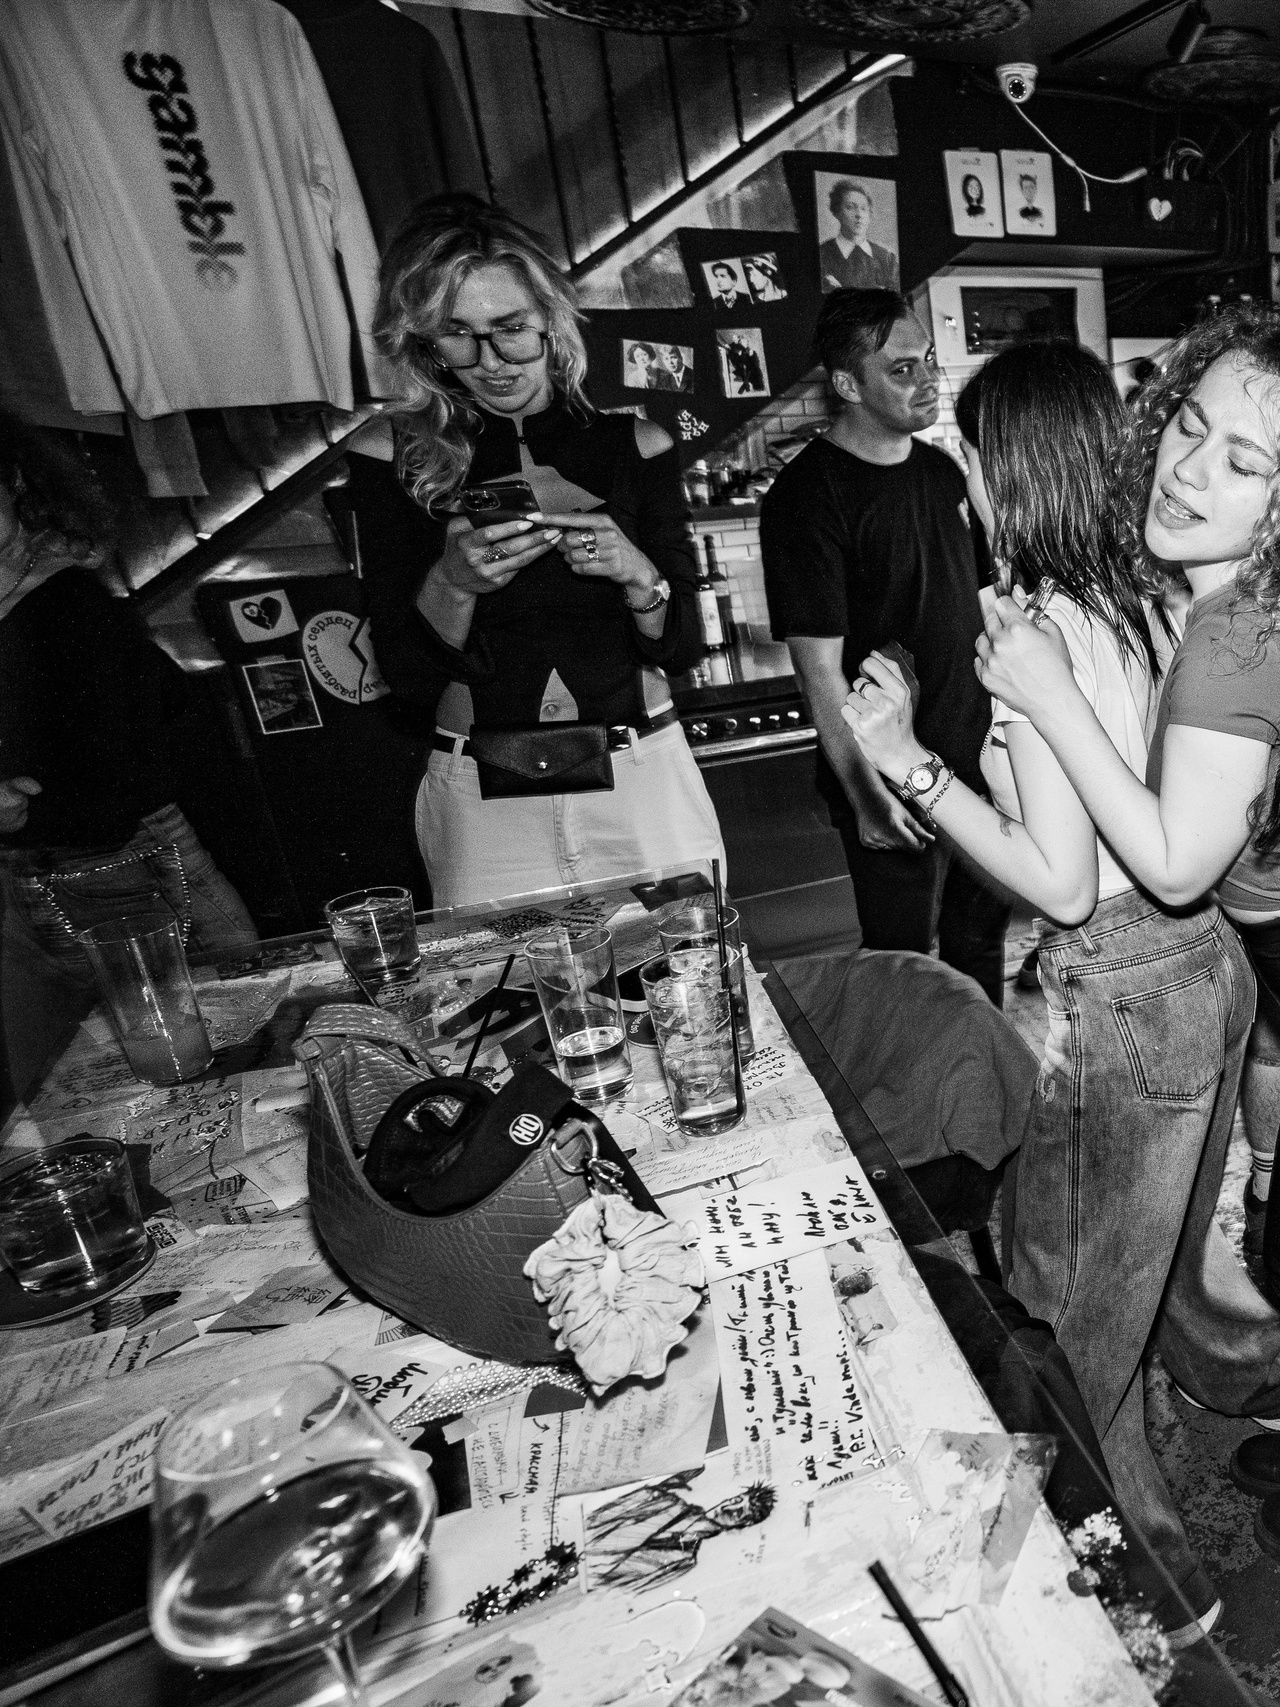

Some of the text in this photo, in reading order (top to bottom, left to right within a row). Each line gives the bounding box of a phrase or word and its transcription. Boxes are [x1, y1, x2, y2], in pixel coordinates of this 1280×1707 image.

[121, 50, 246, 294] gamble
[308, 615, 355, 641] сердец
[307, 644, 358, 700] разбитых
